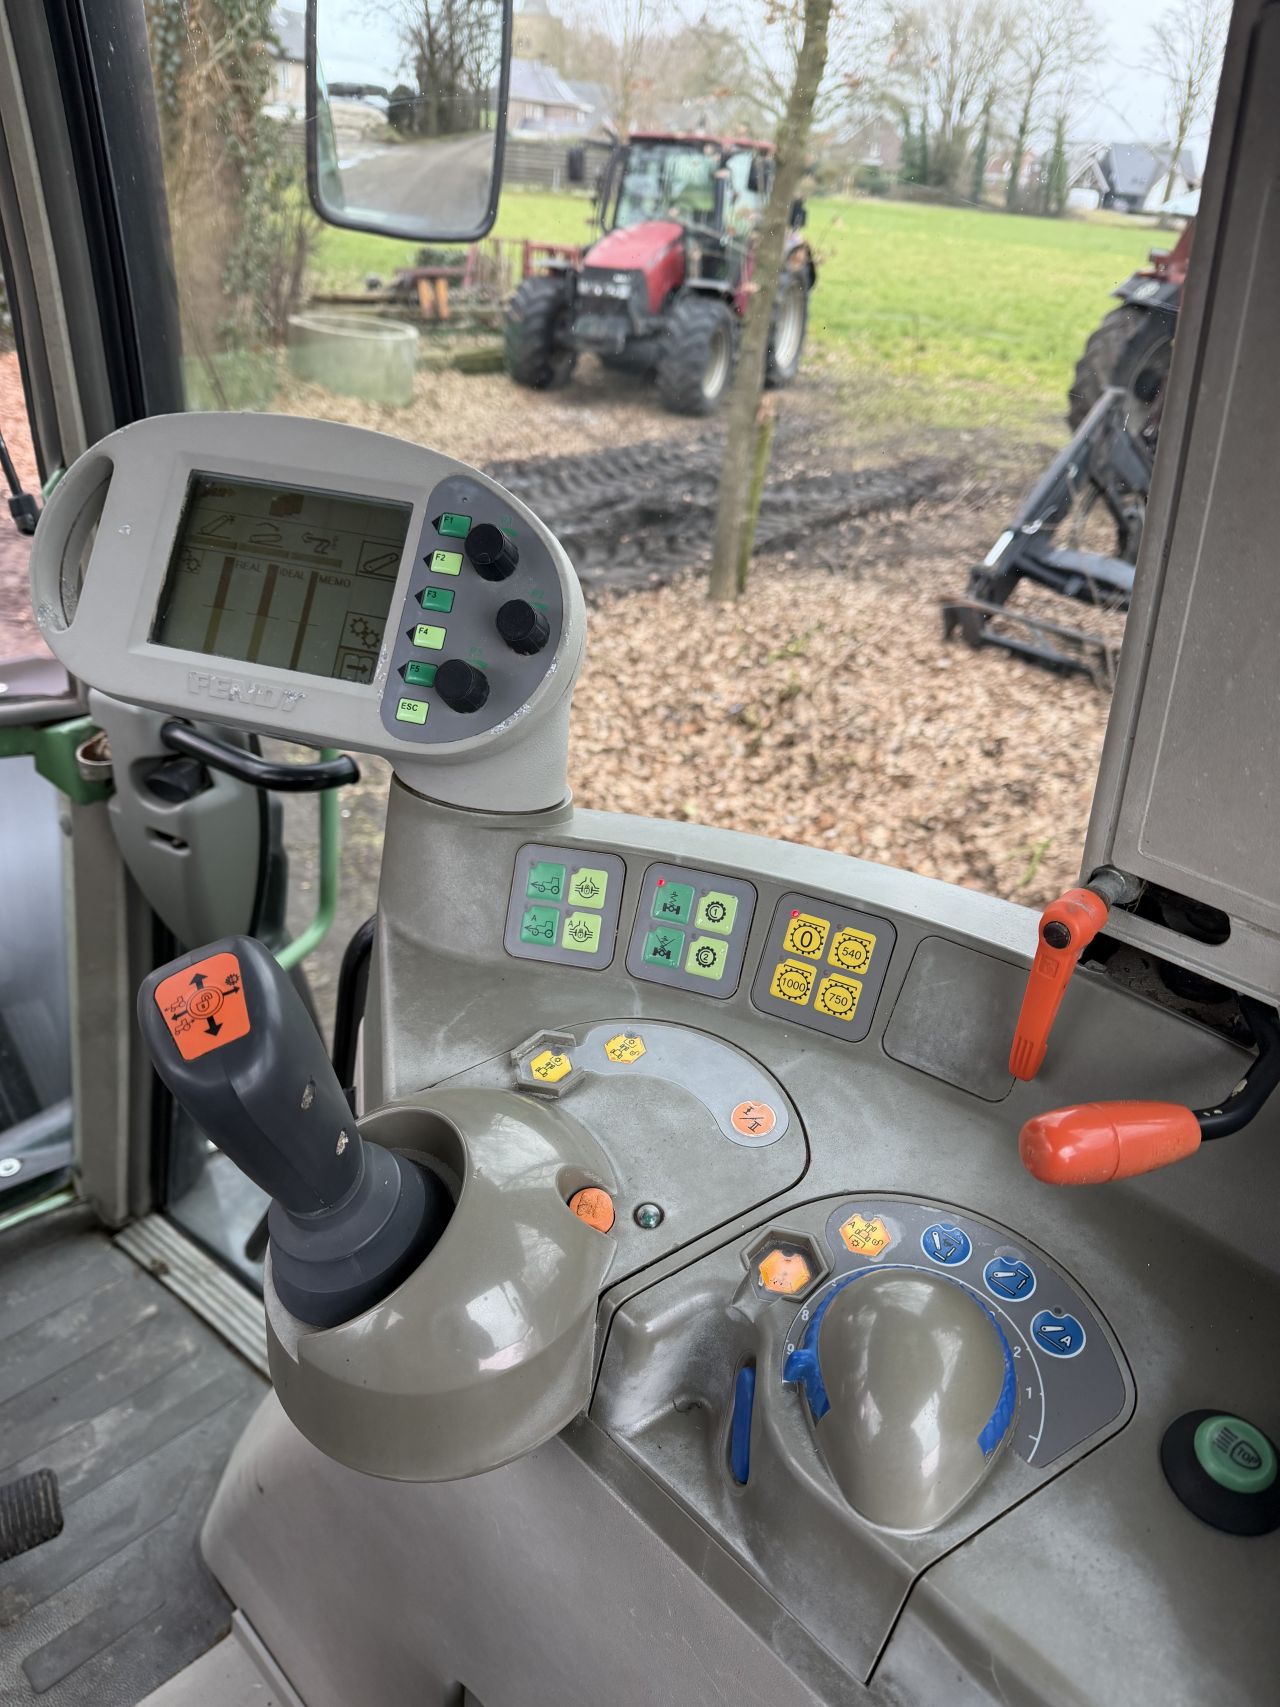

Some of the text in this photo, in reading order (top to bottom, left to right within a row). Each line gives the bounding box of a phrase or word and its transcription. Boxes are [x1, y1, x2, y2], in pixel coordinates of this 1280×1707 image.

[444, 516, 453, 525] F1
[435, 553, 446, 562] F2
[235, 560, 352, 589] REAL IDEAL MEMO
[427, 590, 437, 598] F3
[418, 627, 429, 636] F4
[409, 664, 420, 673] F5
[400, 702, 419, 713] ESC
[713, 908, 718, 916] 1
[531, 914, 537, 922] A
[568, 919, 574, 928] A
[800, 930, 813, 948] 0
[703, 953, 709, 961] 2
[841, 946, 862, 960] 540
[781, 977, 806, 993] 1000
[829, 992, 848, 1007] 750
[848, 1221, 856, 1229] A
[801, 1309, 810, 1321] 8
[1060, 1335, 1072, 1347] A
[786, 1343, 795, 1355] 9
[1013, 1346, 1022, 1358] 2
[1026, 1387, 1032, 1399] 1
[1237, 1446, 1259, 1465] TOP
